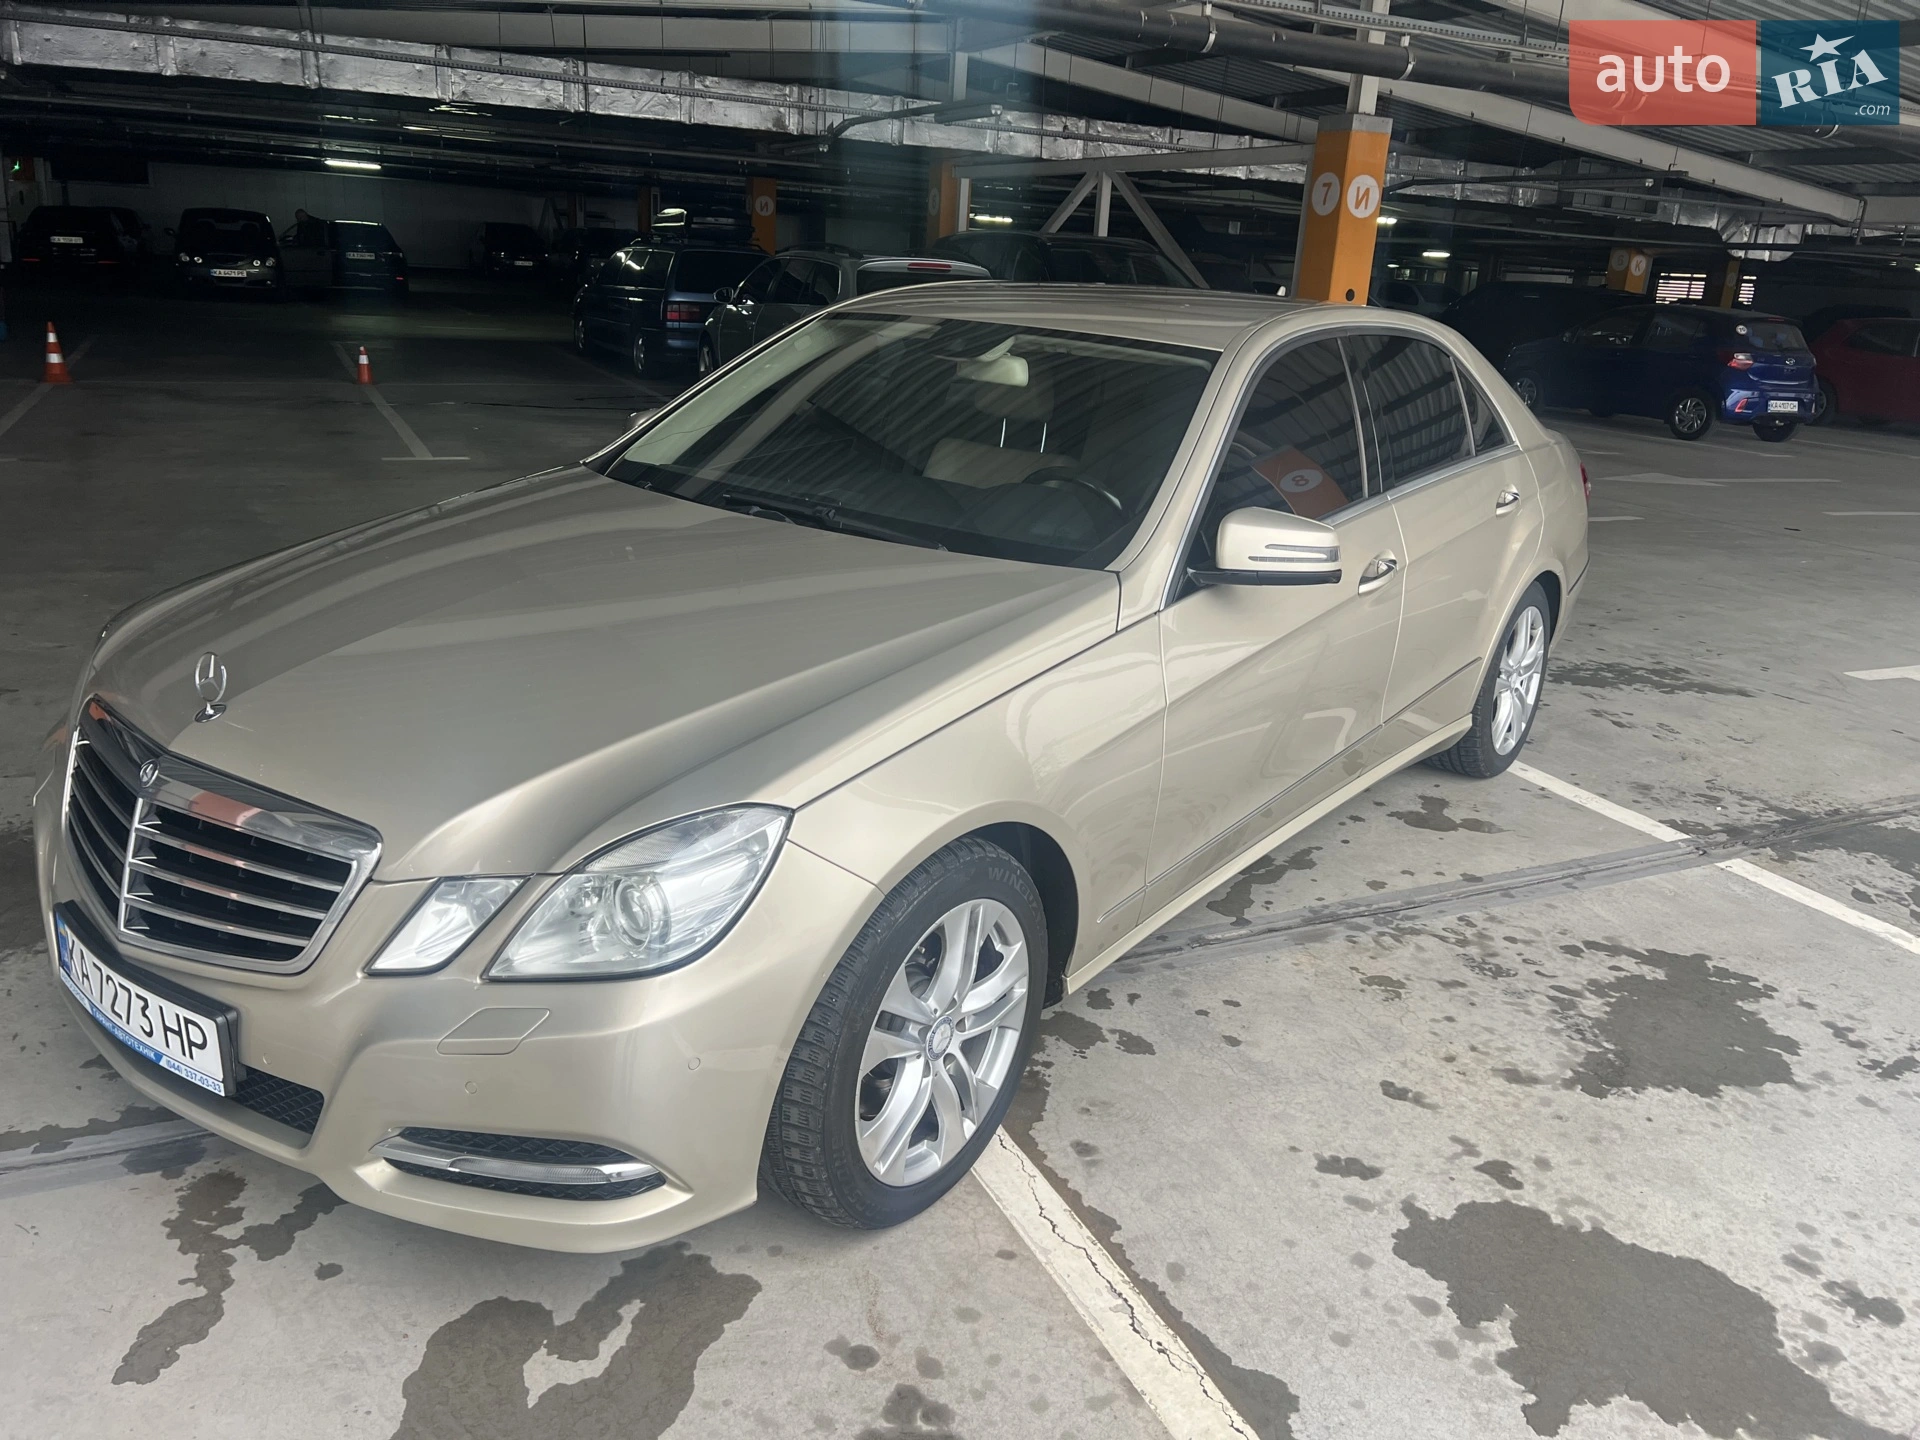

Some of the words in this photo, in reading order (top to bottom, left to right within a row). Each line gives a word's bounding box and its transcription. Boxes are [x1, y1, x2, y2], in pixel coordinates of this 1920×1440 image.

[1321, 182, 1332, 206] 7
[66, 925, 93, 997] KA
[92, 962, 154, 1038] 7273
[159, 1005, 208, 1061] HP
[166, 1060, 183, 1076] (044)
[184, 1068, 222, 1093] 337-03-33
